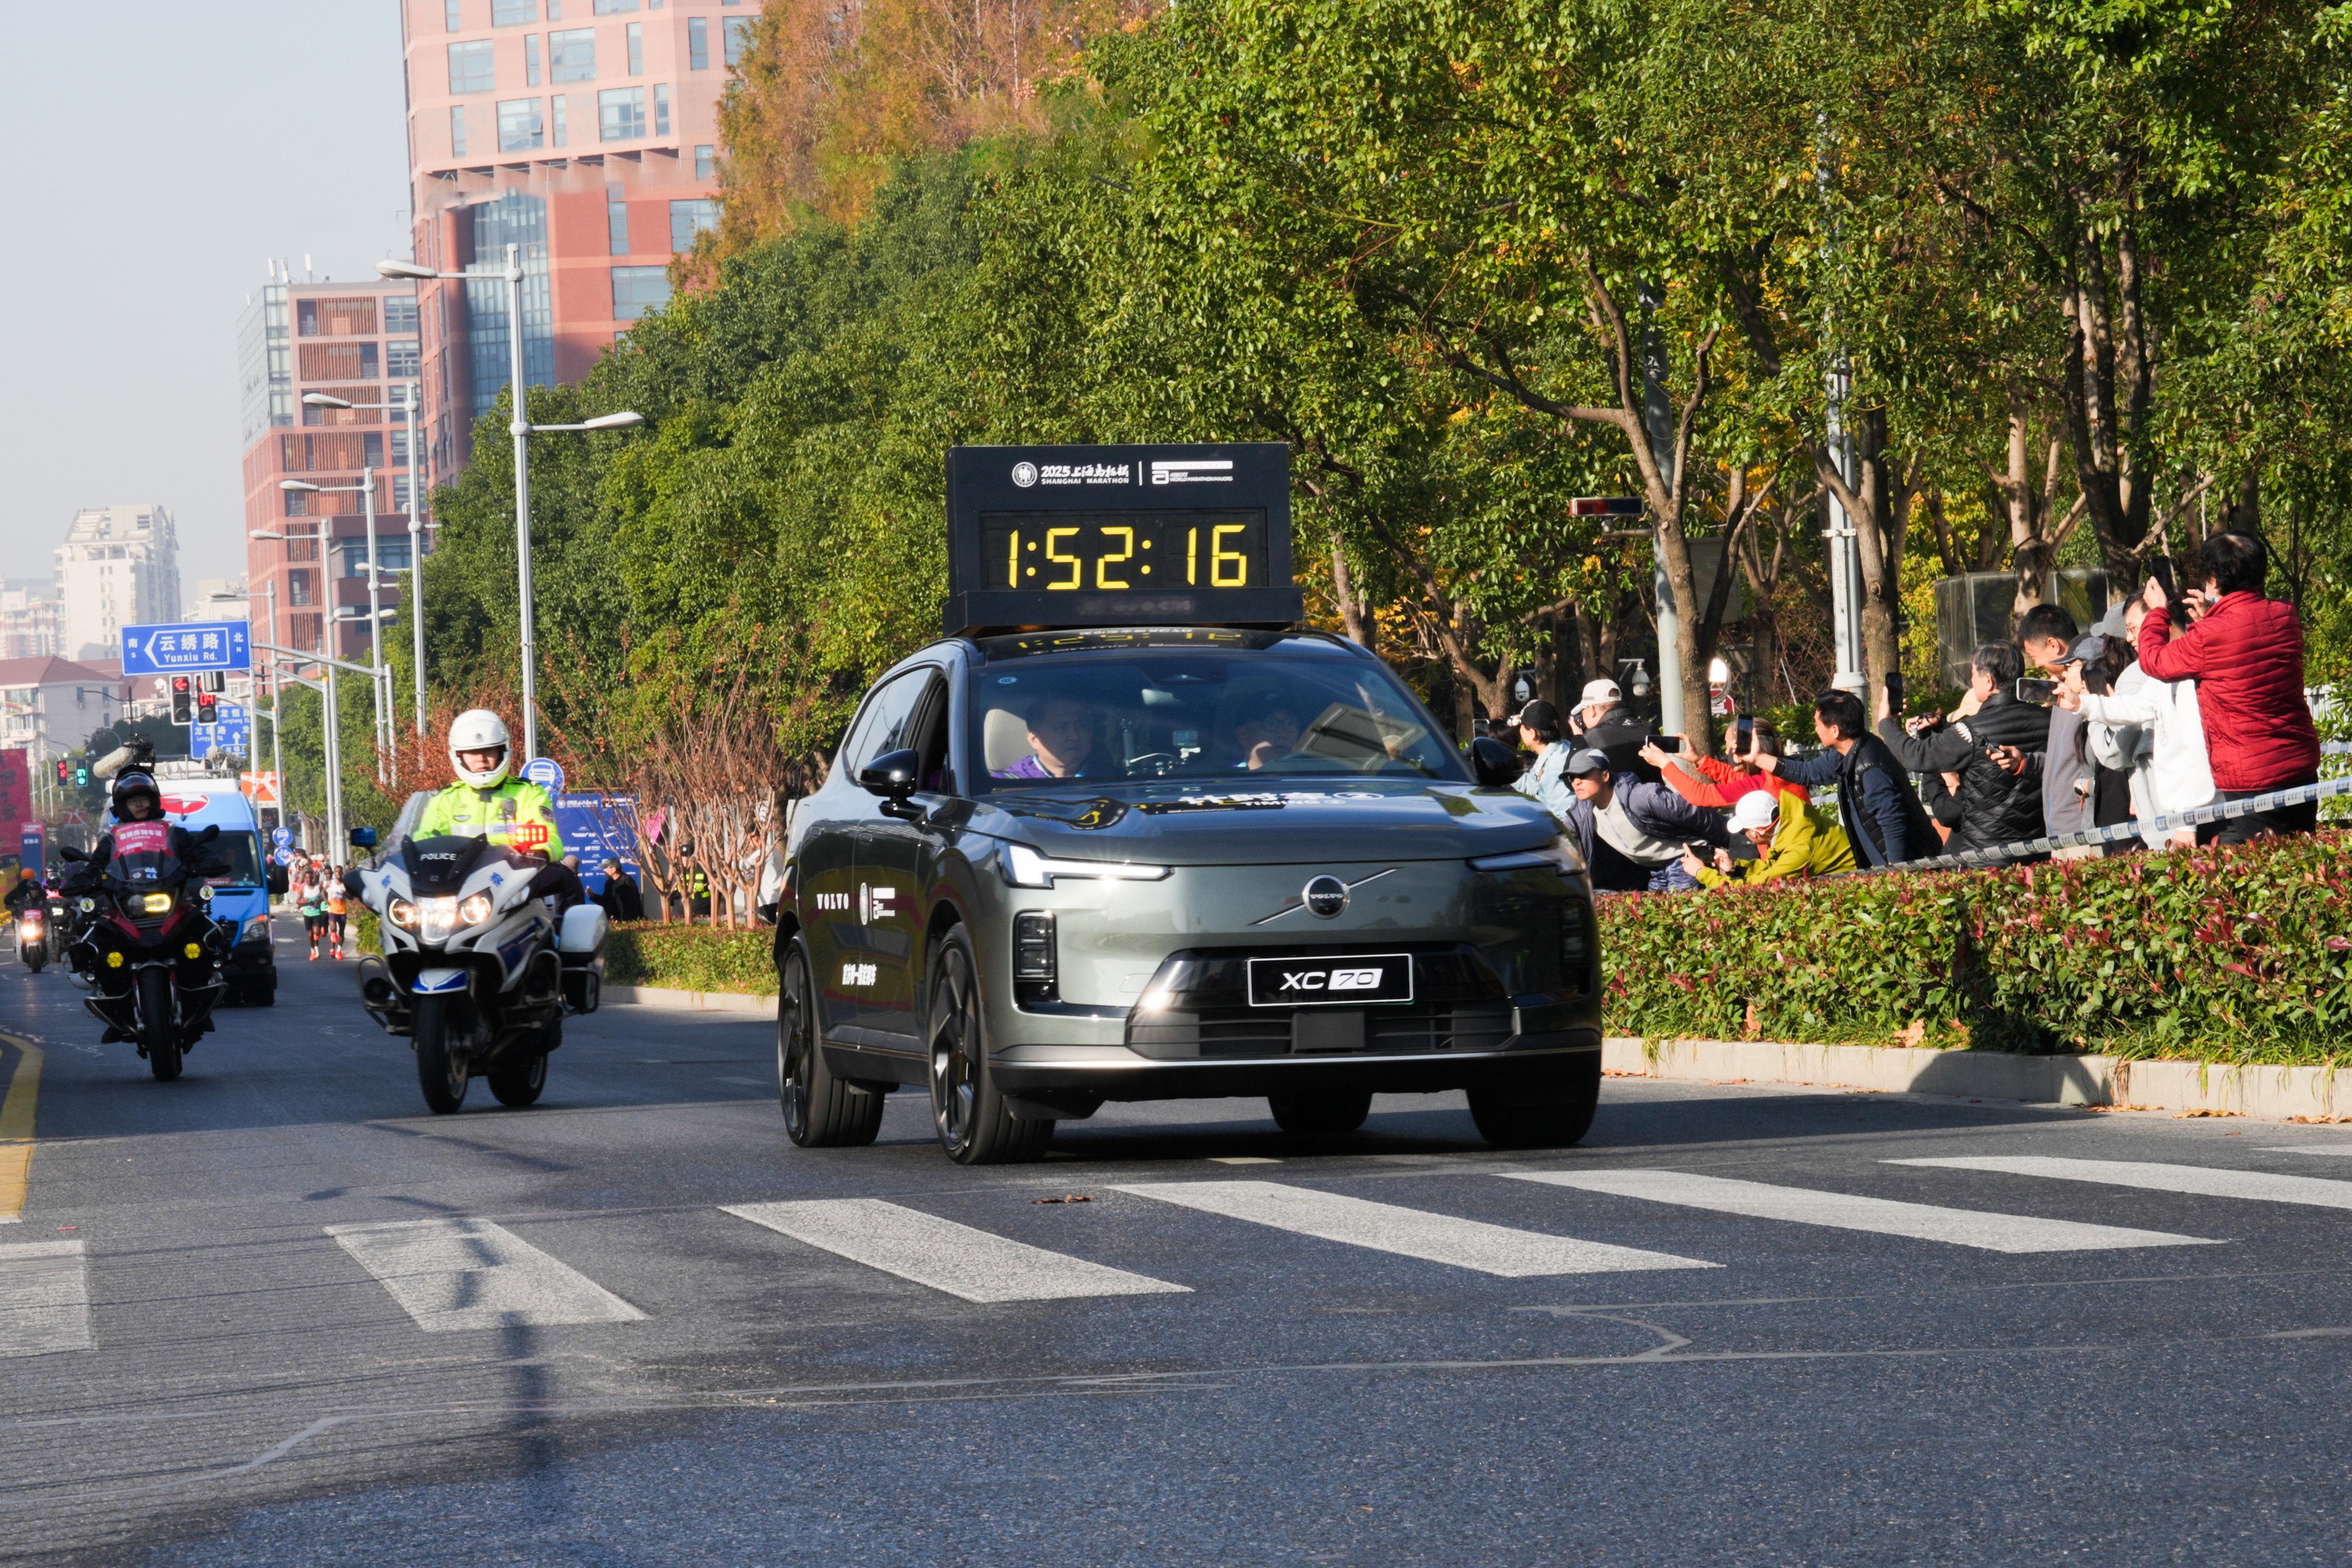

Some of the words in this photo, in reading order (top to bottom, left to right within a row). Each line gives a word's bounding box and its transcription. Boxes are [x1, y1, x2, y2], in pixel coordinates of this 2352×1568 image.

[159, 632, 219, 652] 云绣路
[233, 632, 244, 643] 北
[128, 638, 138, 649] 南
[164, 652, 198, 663] Yunxiu
[203, 652, 217, 661] Rd.
[420, 853, 457, 861] POLICE
[816, 893, 849, 910] VOLVO
[1279, 971, 1375, 990] XC70
